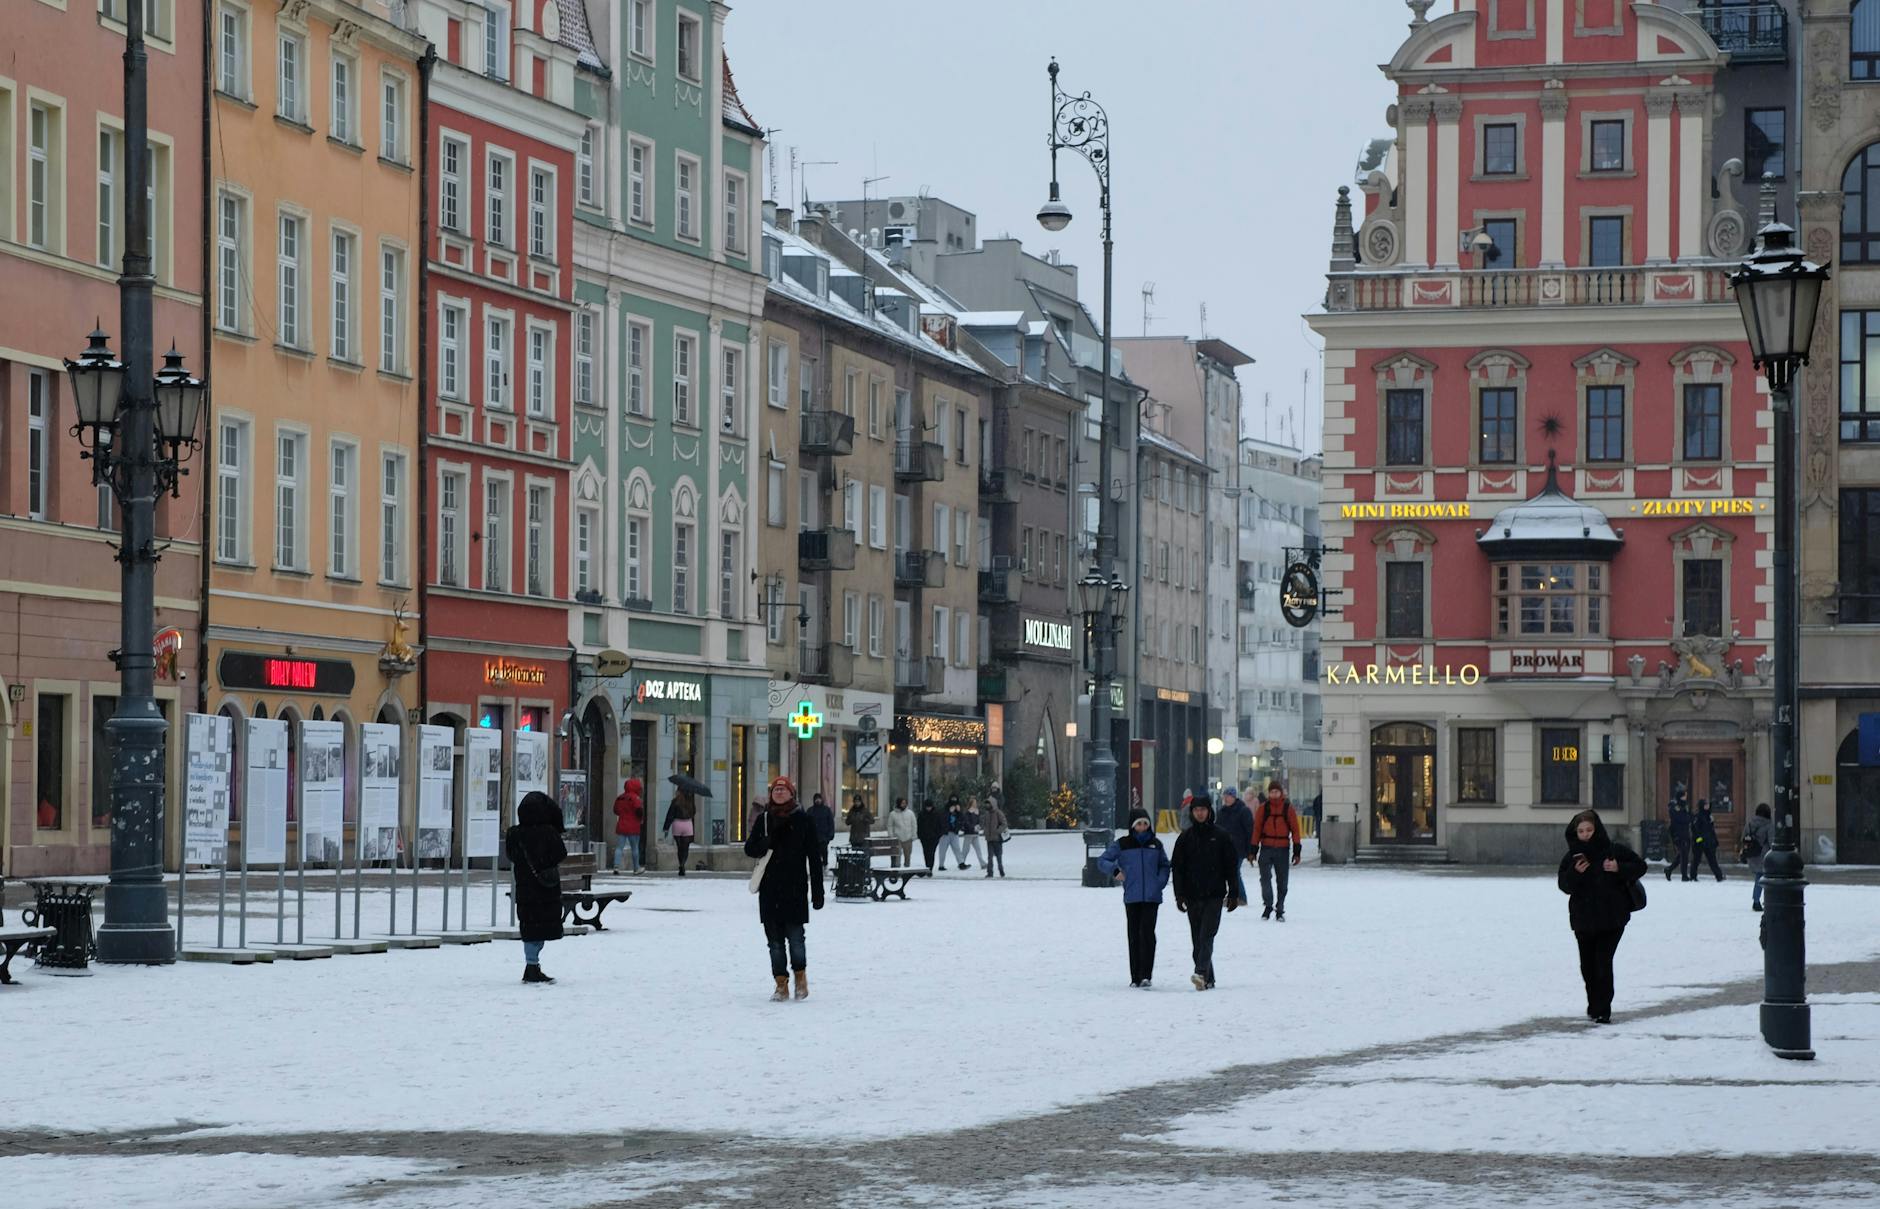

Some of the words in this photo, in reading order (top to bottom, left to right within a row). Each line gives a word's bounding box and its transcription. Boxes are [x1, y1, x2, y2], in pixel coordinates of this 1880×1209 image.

[1341, 504, 1385, 518] MINI
[1391, 503, 1471, 517] BROWAR
[1711, 500, 1753, 514] PIES
[1025, 618, 1071, 650] MOLLINARI
[1512, 654, 1583, 668] BROWAR
[1327, 664, 1480, 685] KARMELLO
[645, 679, 665, 699] DOZ
[666, 680, 702, 702] APTEKA
